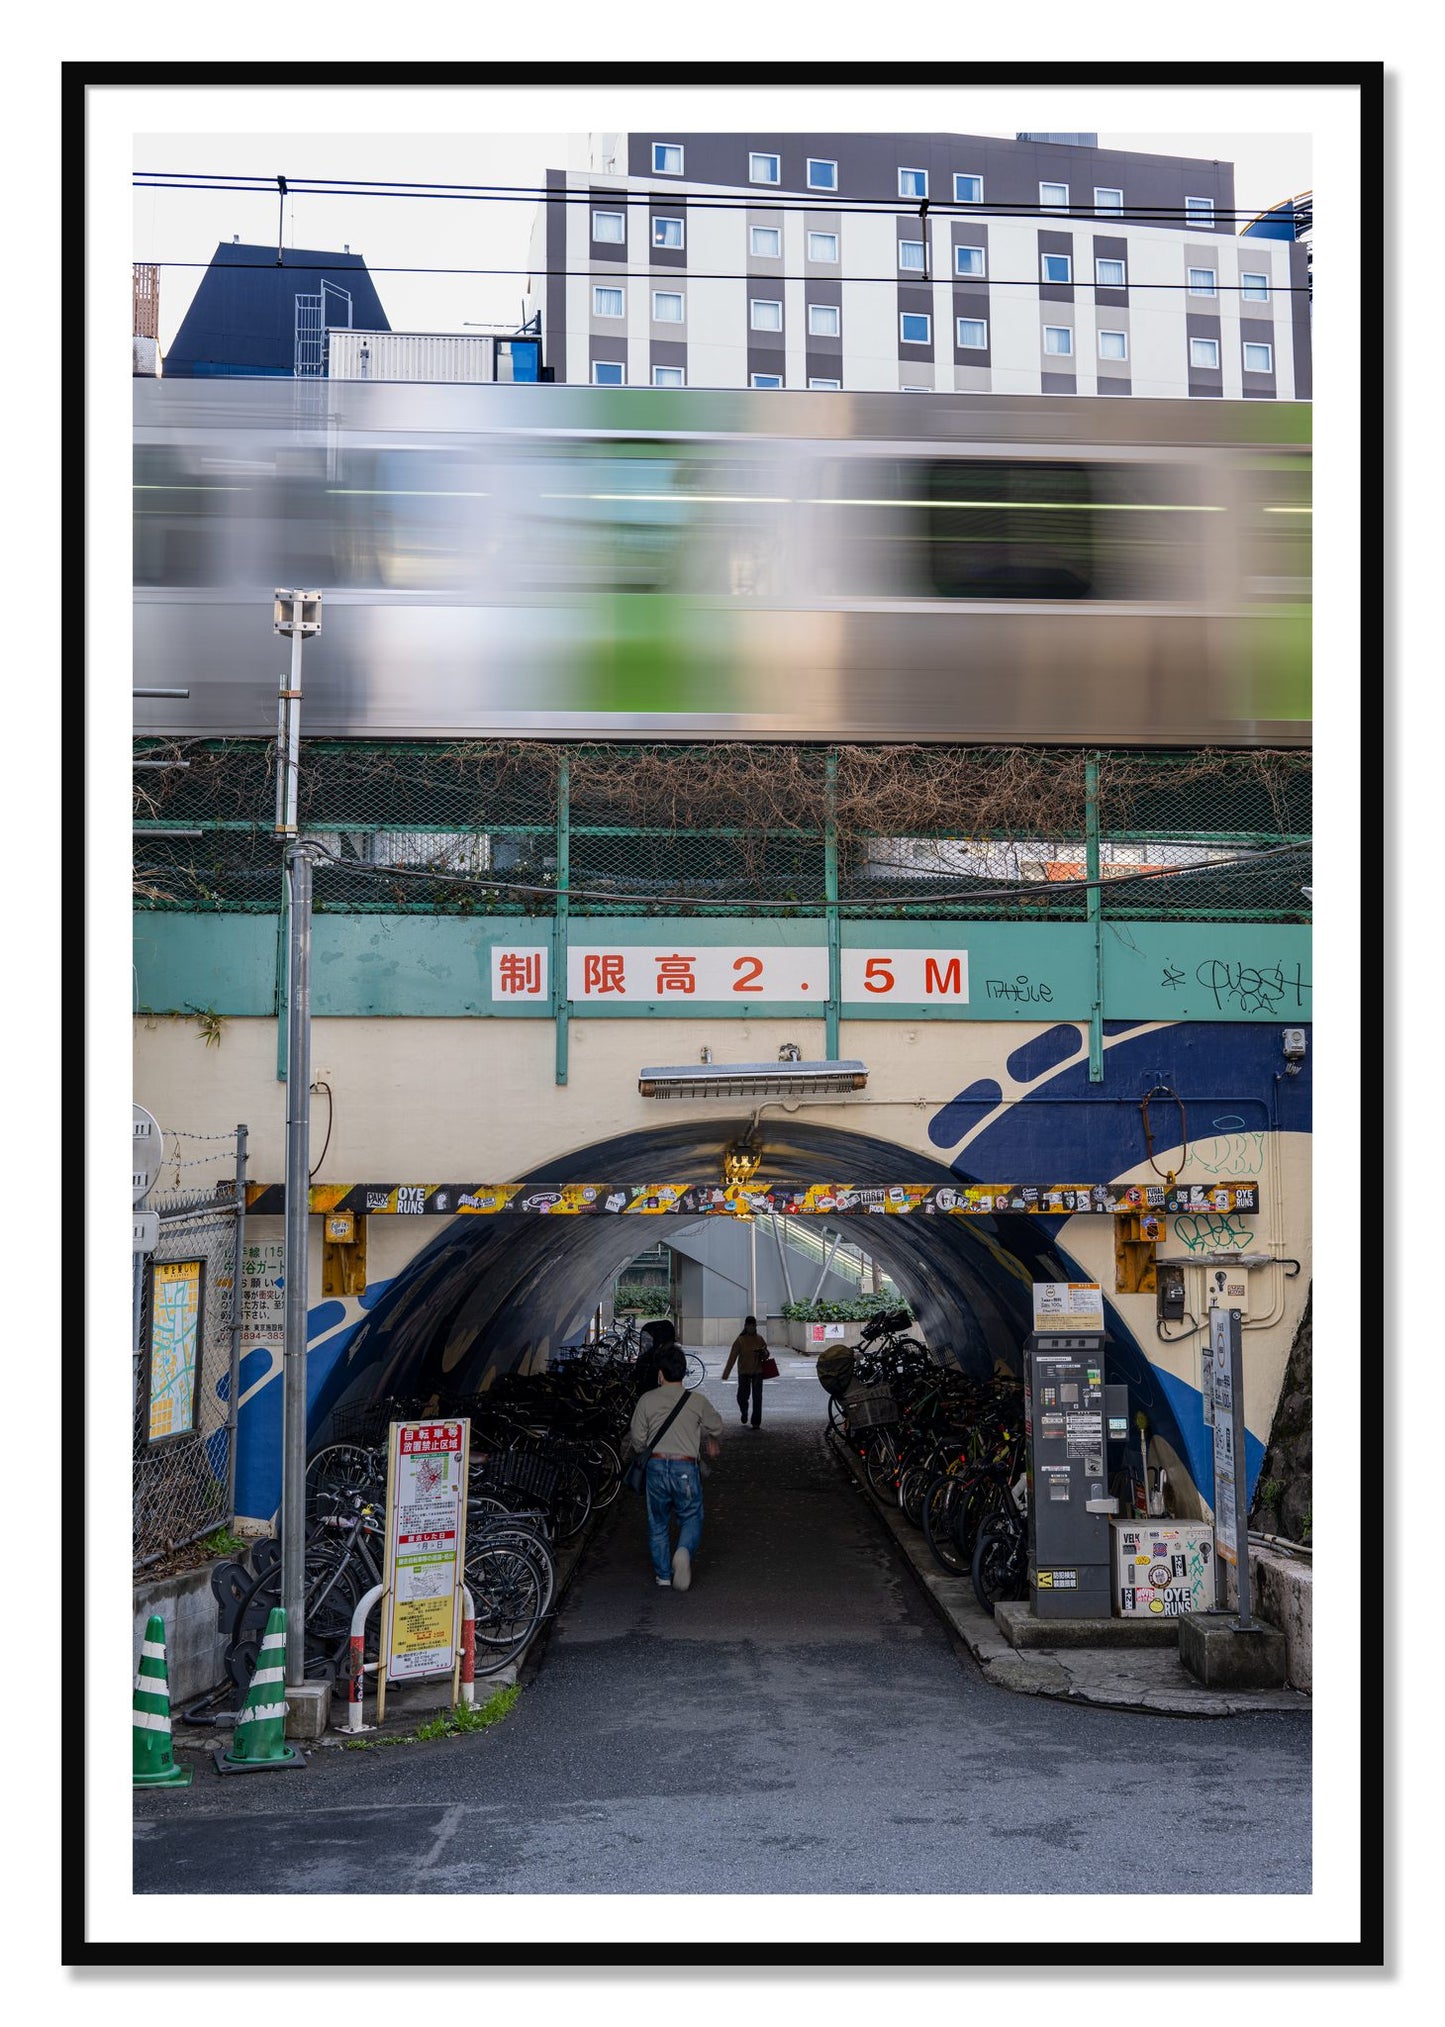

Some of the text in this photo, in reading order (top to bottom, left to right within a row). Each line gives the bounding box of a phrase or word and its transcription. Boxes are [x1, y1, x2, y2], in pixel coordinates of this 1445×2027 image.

[398, 1187, 425, 1201] OYE
[1236, 1189, 1253, 1198] OYE
[397, 1200, 424, 1214] RUNS
[1236, 1198, 1253, 1207] RUNS
[403, 1439, 458, 1452] 放置禁止区域
[1164, 1588, 1190, 1602] OYE
[1165, 1602, 1191, 1616] RUNS
